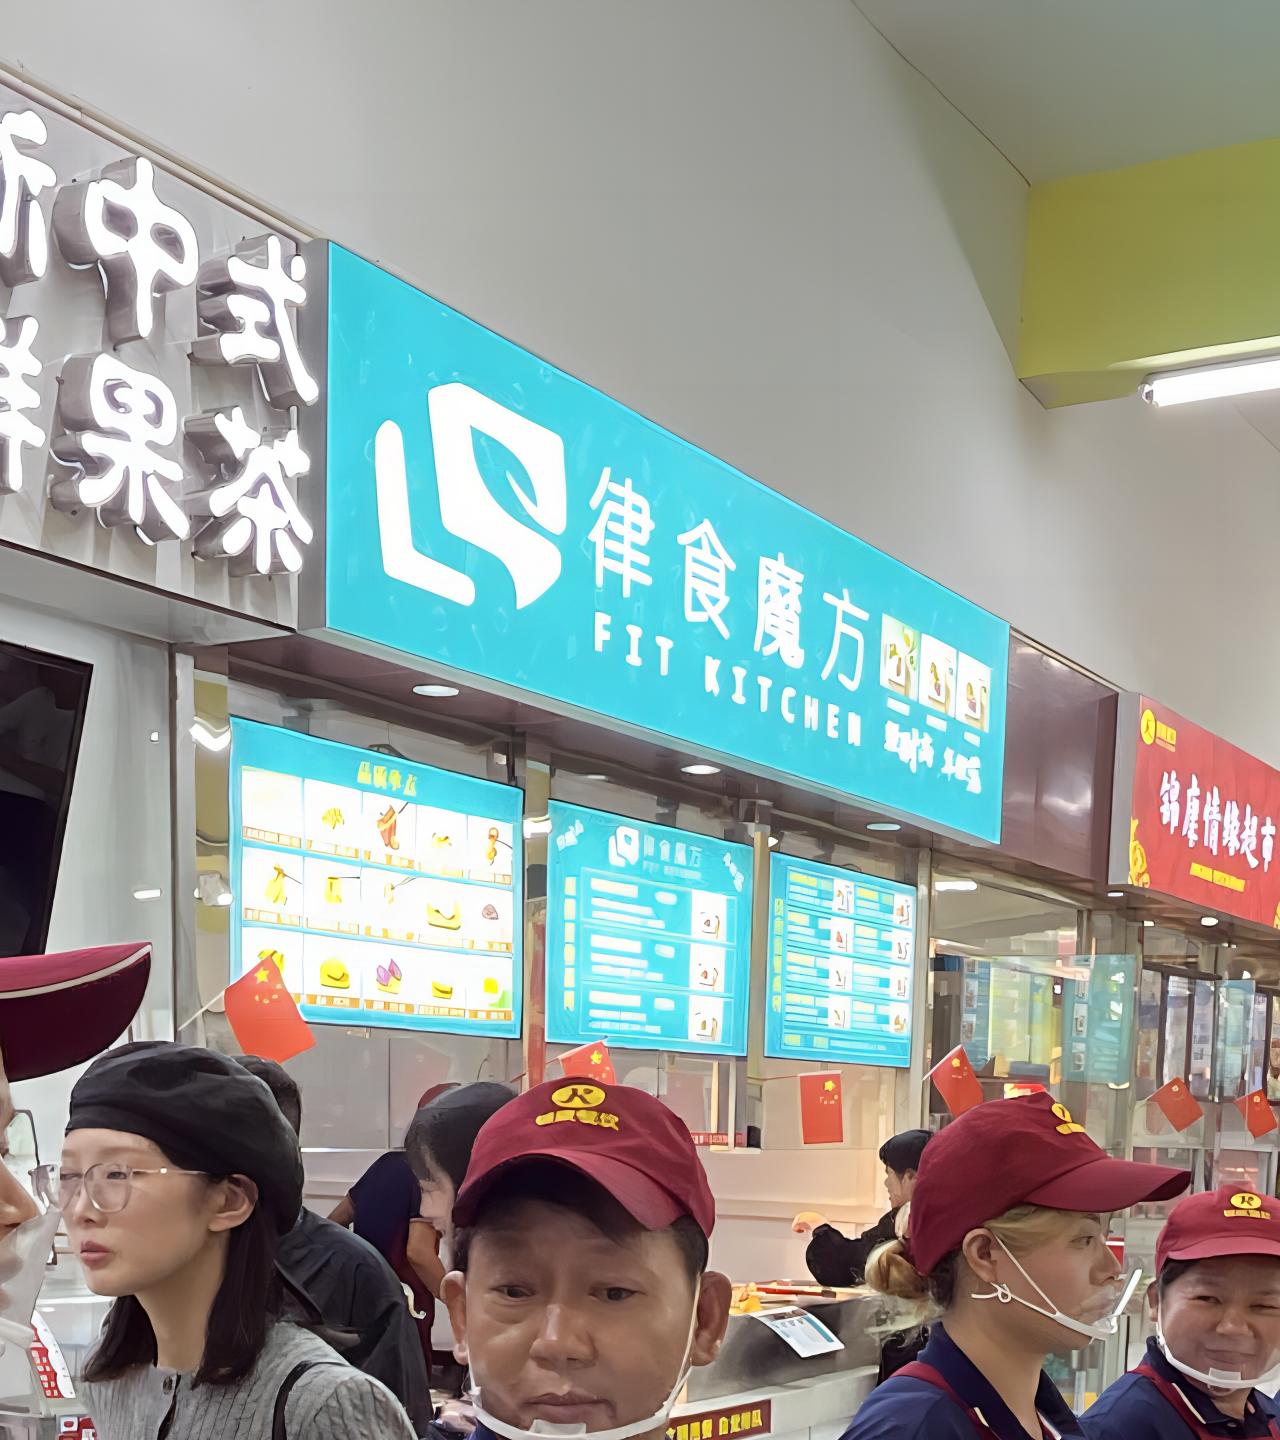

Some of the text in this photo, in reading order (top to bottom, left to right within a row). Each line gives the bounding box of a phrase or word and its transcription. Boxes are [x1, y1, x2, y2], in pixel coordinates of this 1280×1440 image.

[587, 465, 871, 693] 律食魔方
[594, 611, 862, 747] FIT KITCHEN
